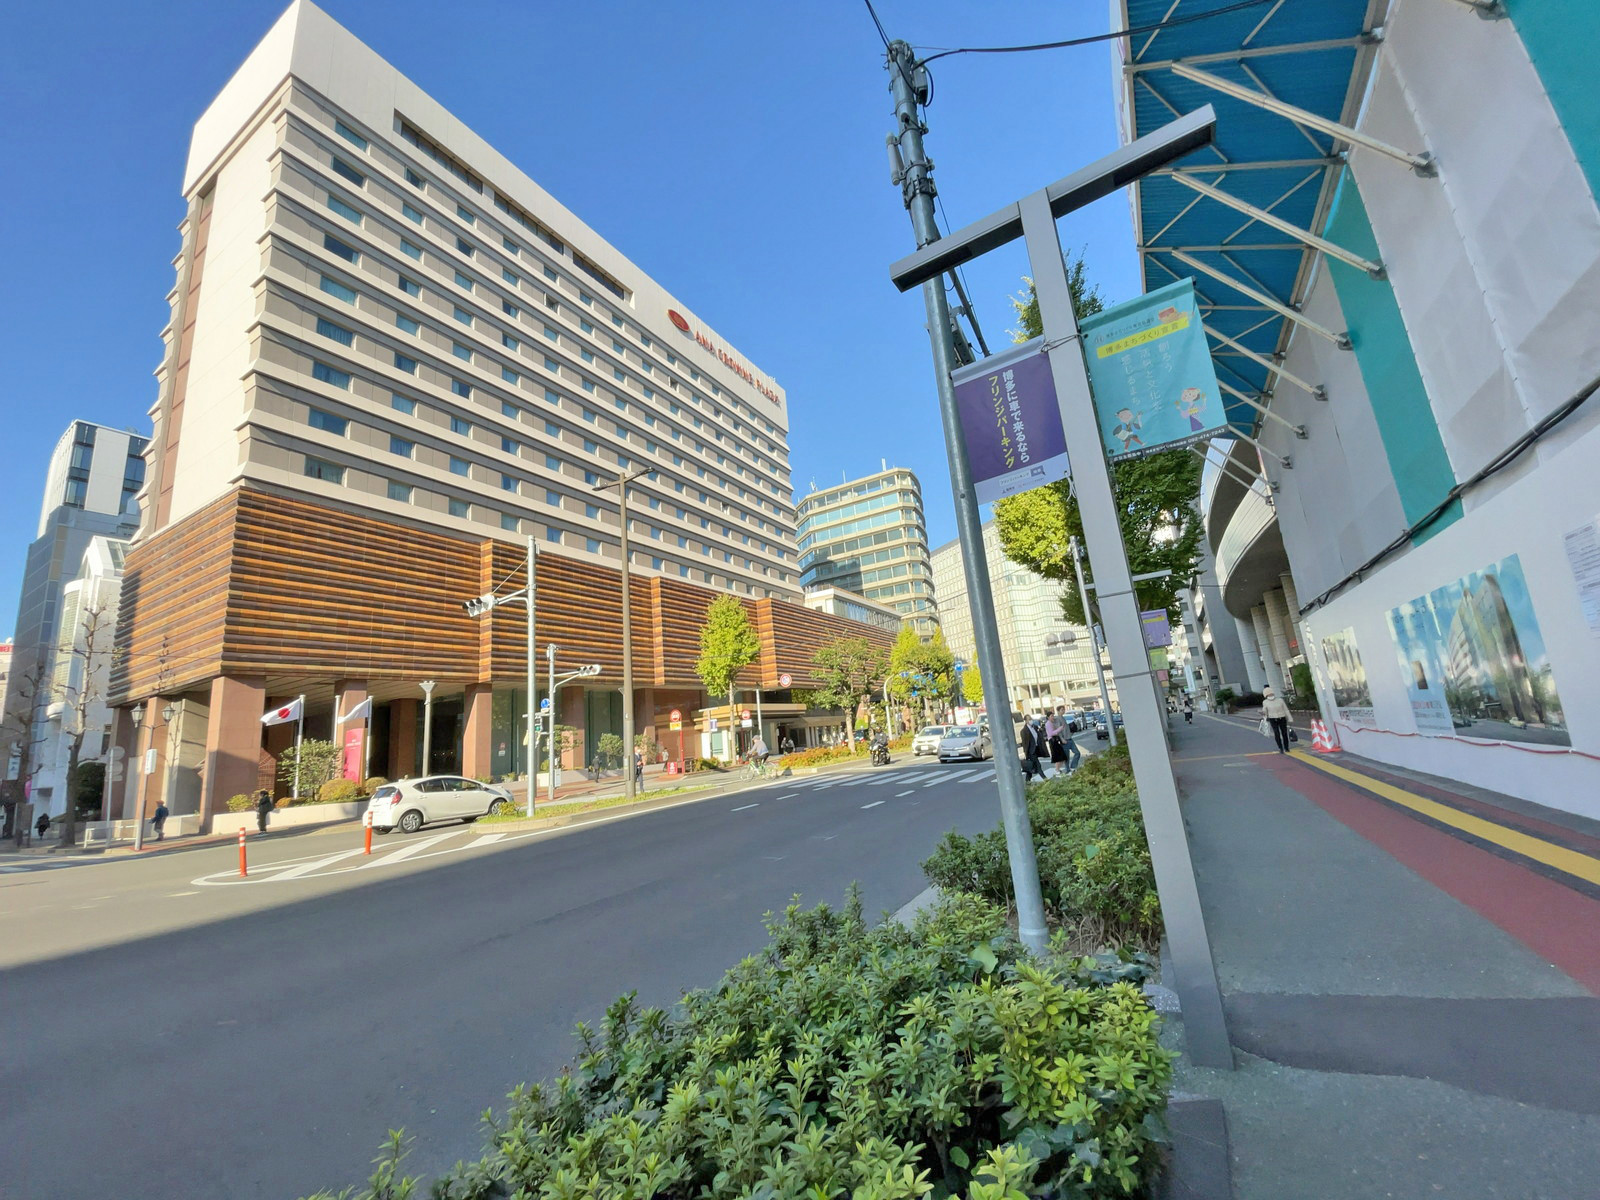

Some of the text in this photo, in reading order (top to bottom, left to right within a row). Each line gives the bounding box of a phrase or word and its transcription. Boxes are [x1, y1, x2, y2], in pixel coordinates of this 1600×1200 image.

[695, 330, 779, 404] ANA CROWNE PLAZA
[988, 375, 1015, 469] フリンジパーキング
[1002, 369, 1030, 464] 博多に車で来るなら
